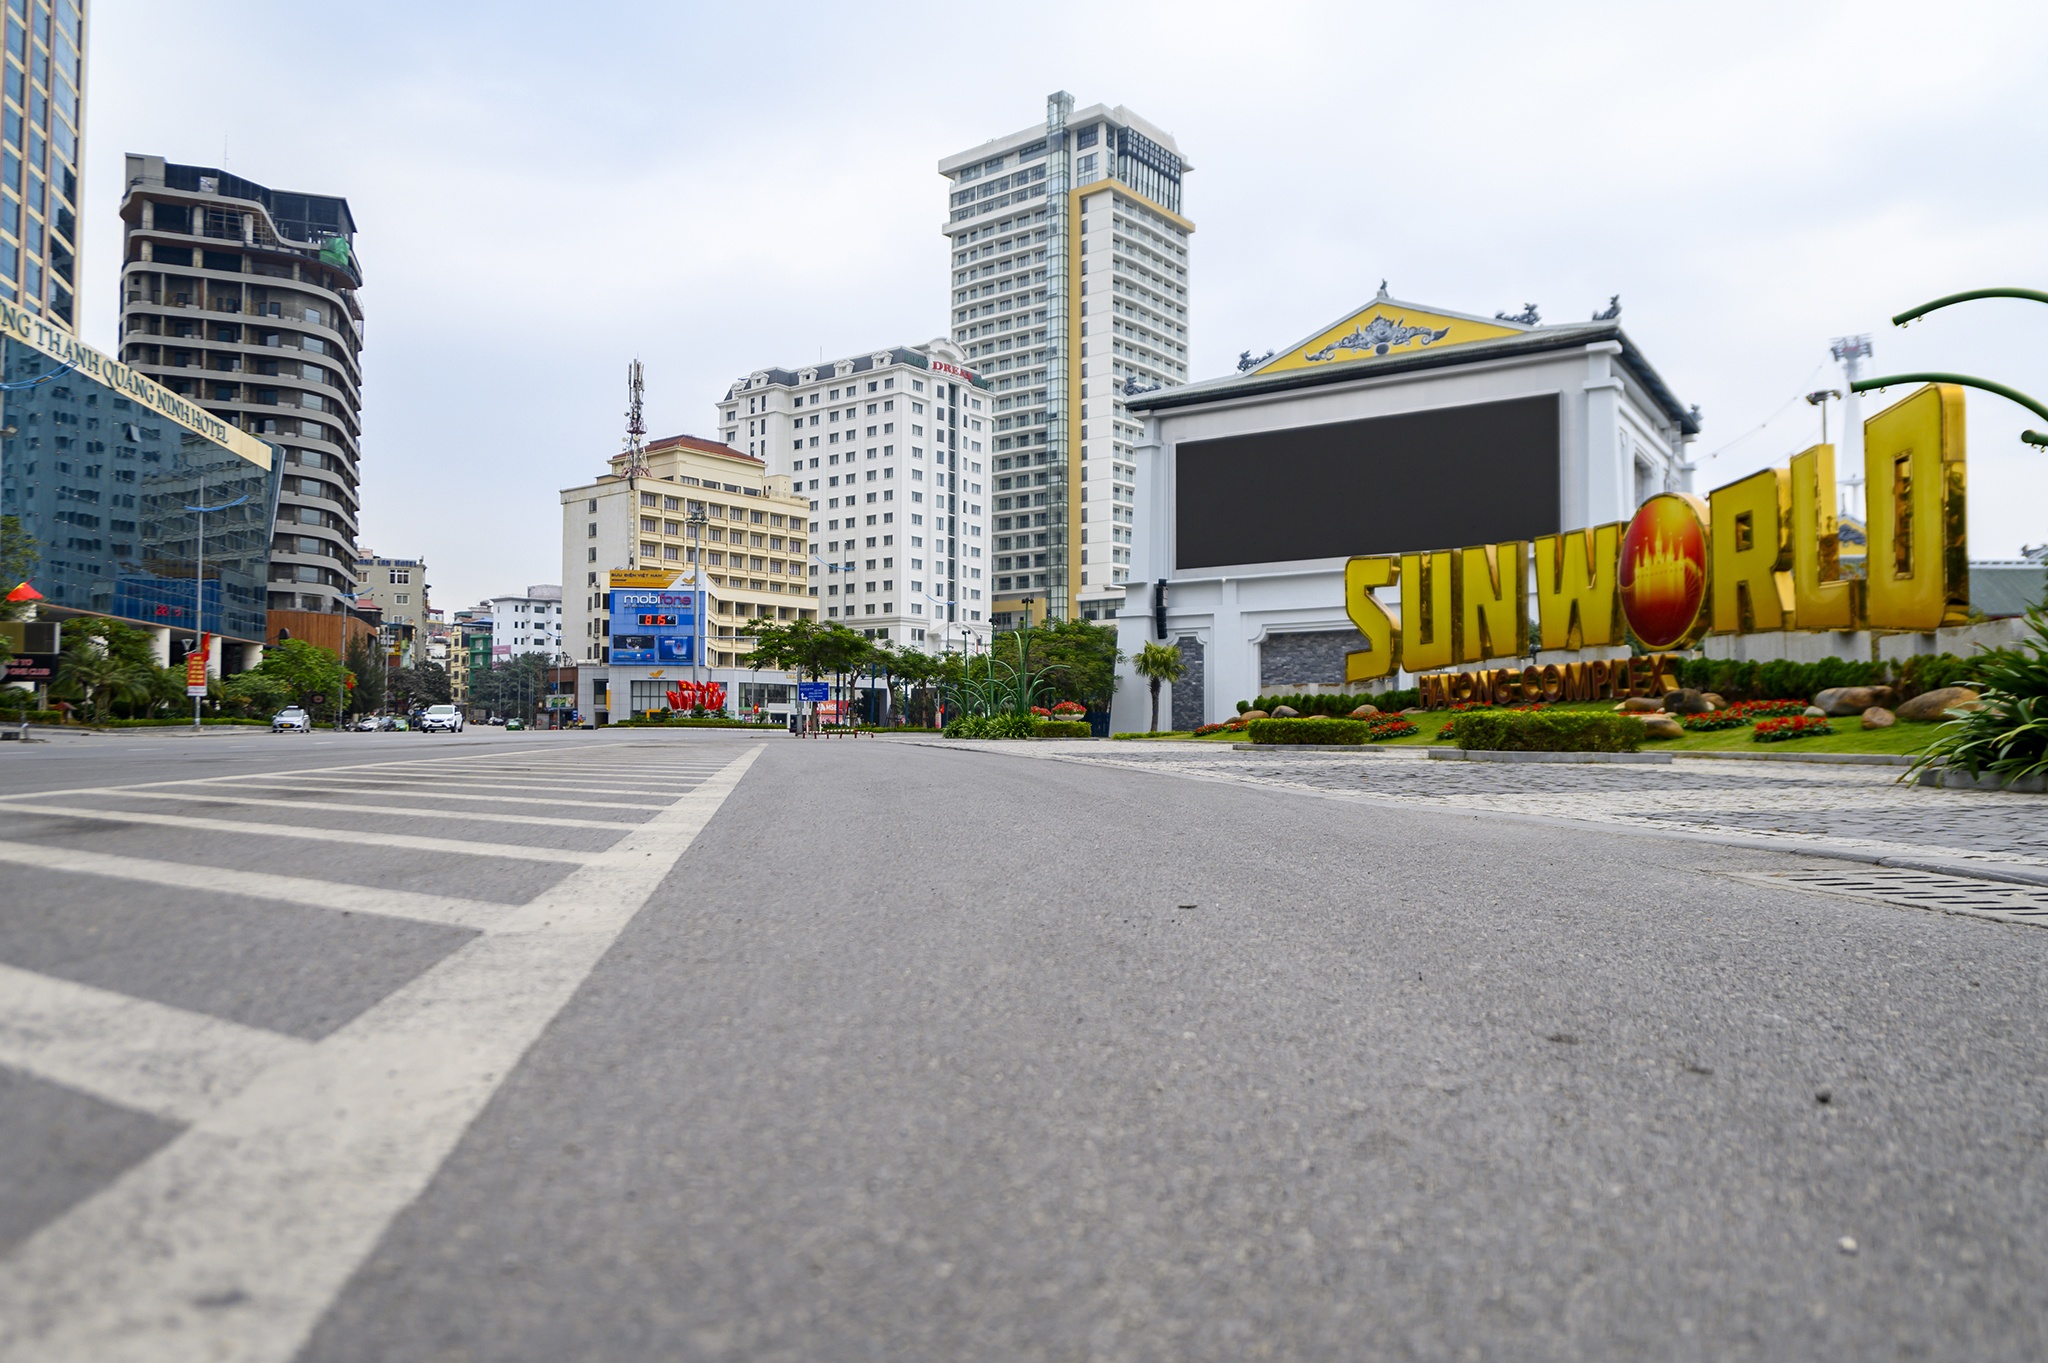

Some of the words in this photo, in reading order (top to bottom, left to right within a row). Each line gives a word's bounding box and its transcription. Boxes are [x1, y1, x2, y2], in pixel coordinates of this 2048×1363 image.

[35, 320, 99, 375] THANH
[157, 388, 190, 424] NINH
[191, 408, 229, 444] HOTEL
[1346, 541, 1530, 684] SUN
[1535, 382, 1970, 652] WORLD
[394, 560, 417, 568] HOTEL
[624, 592, 692, 605] mobifone
[1521, 654, 1678, 702] COMPLEX
